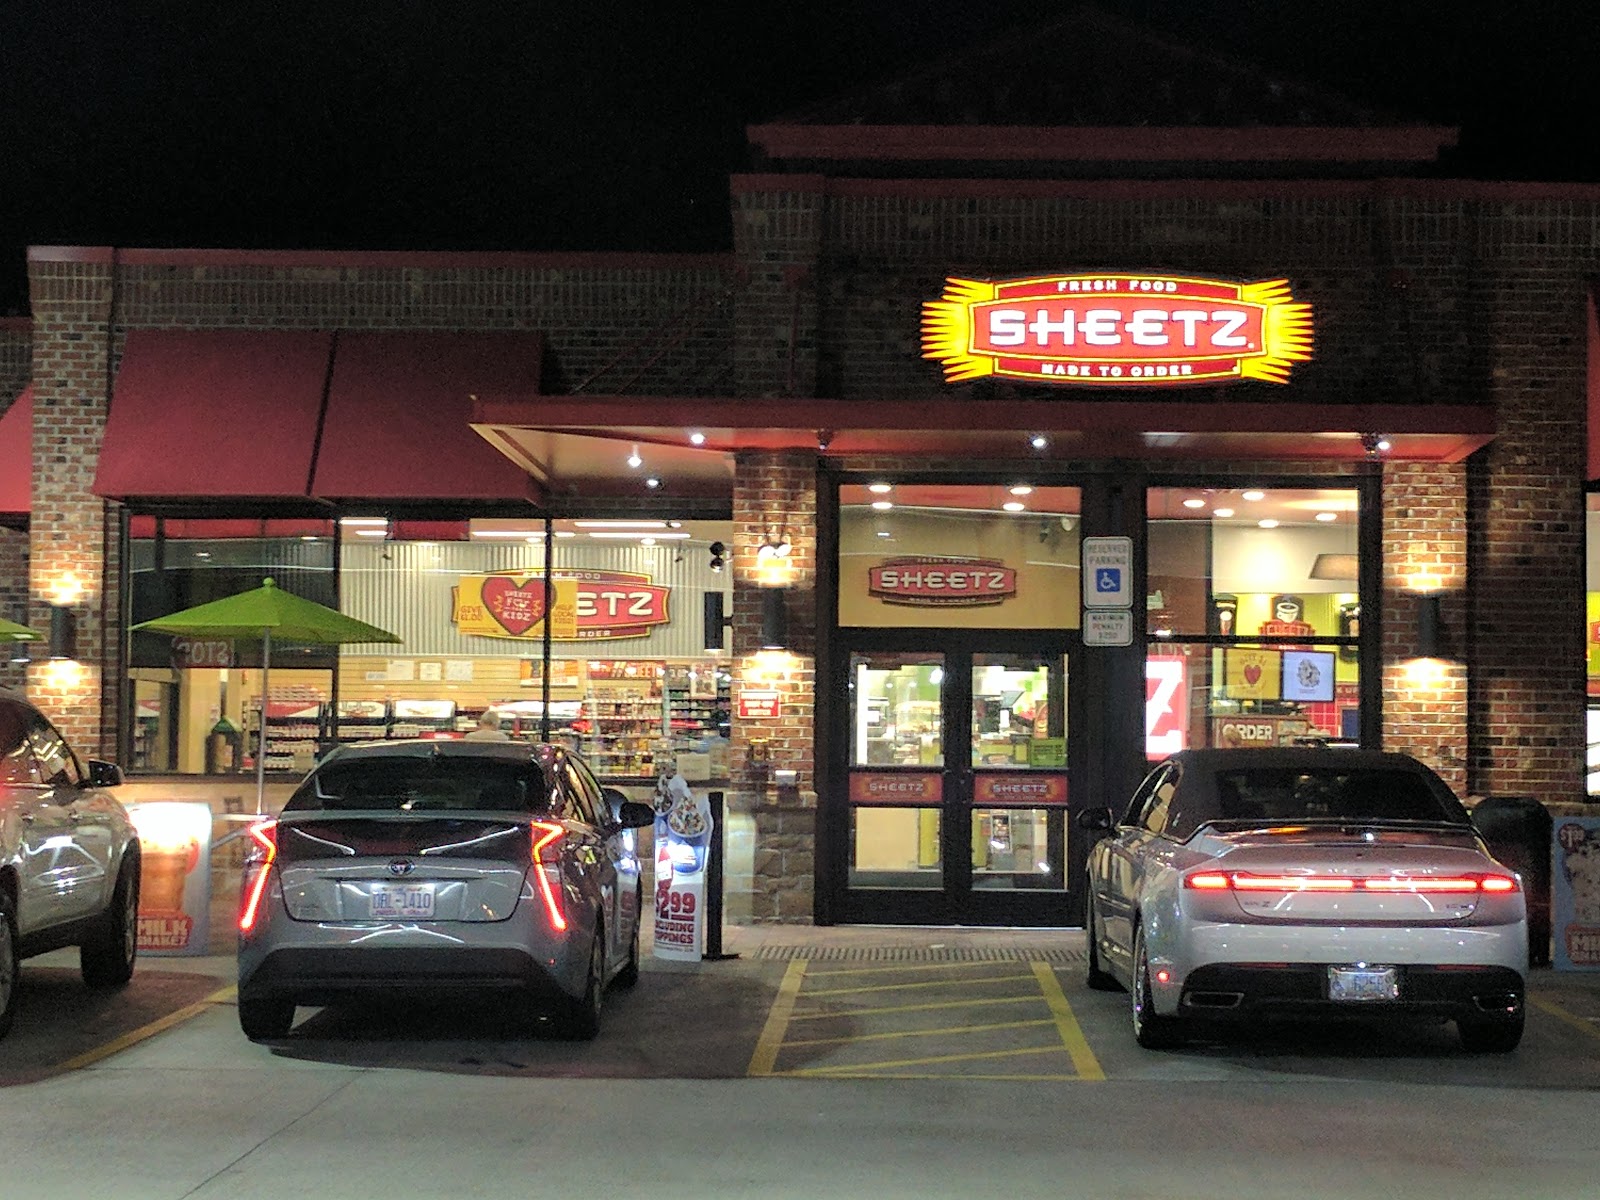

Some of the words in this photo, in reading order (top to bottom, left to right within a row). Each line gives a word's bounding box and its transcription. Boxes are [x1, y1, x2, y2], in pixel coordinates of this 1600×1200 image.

[1057, 279, 1118, 292] FRESH
[1129, 279, 1178, 292] FOOD
[988, 309, 1249, 347] SHEETZ
[1041, 364, 1091, 376] MADE
[1099, 365, 1122, 377] TO
[1131, 364, 1193, 377] ORDER
[1089, 556, 1127, 565] PARKING
[880, 571, 1006, 590] SHEETZ
[577, 591, 653, 617] ETZ
[869, 783, 924, 792] SHEETZ
[992, 784, 1048, 793] SHEETZ
[137, 919, 188, 936] MILK
